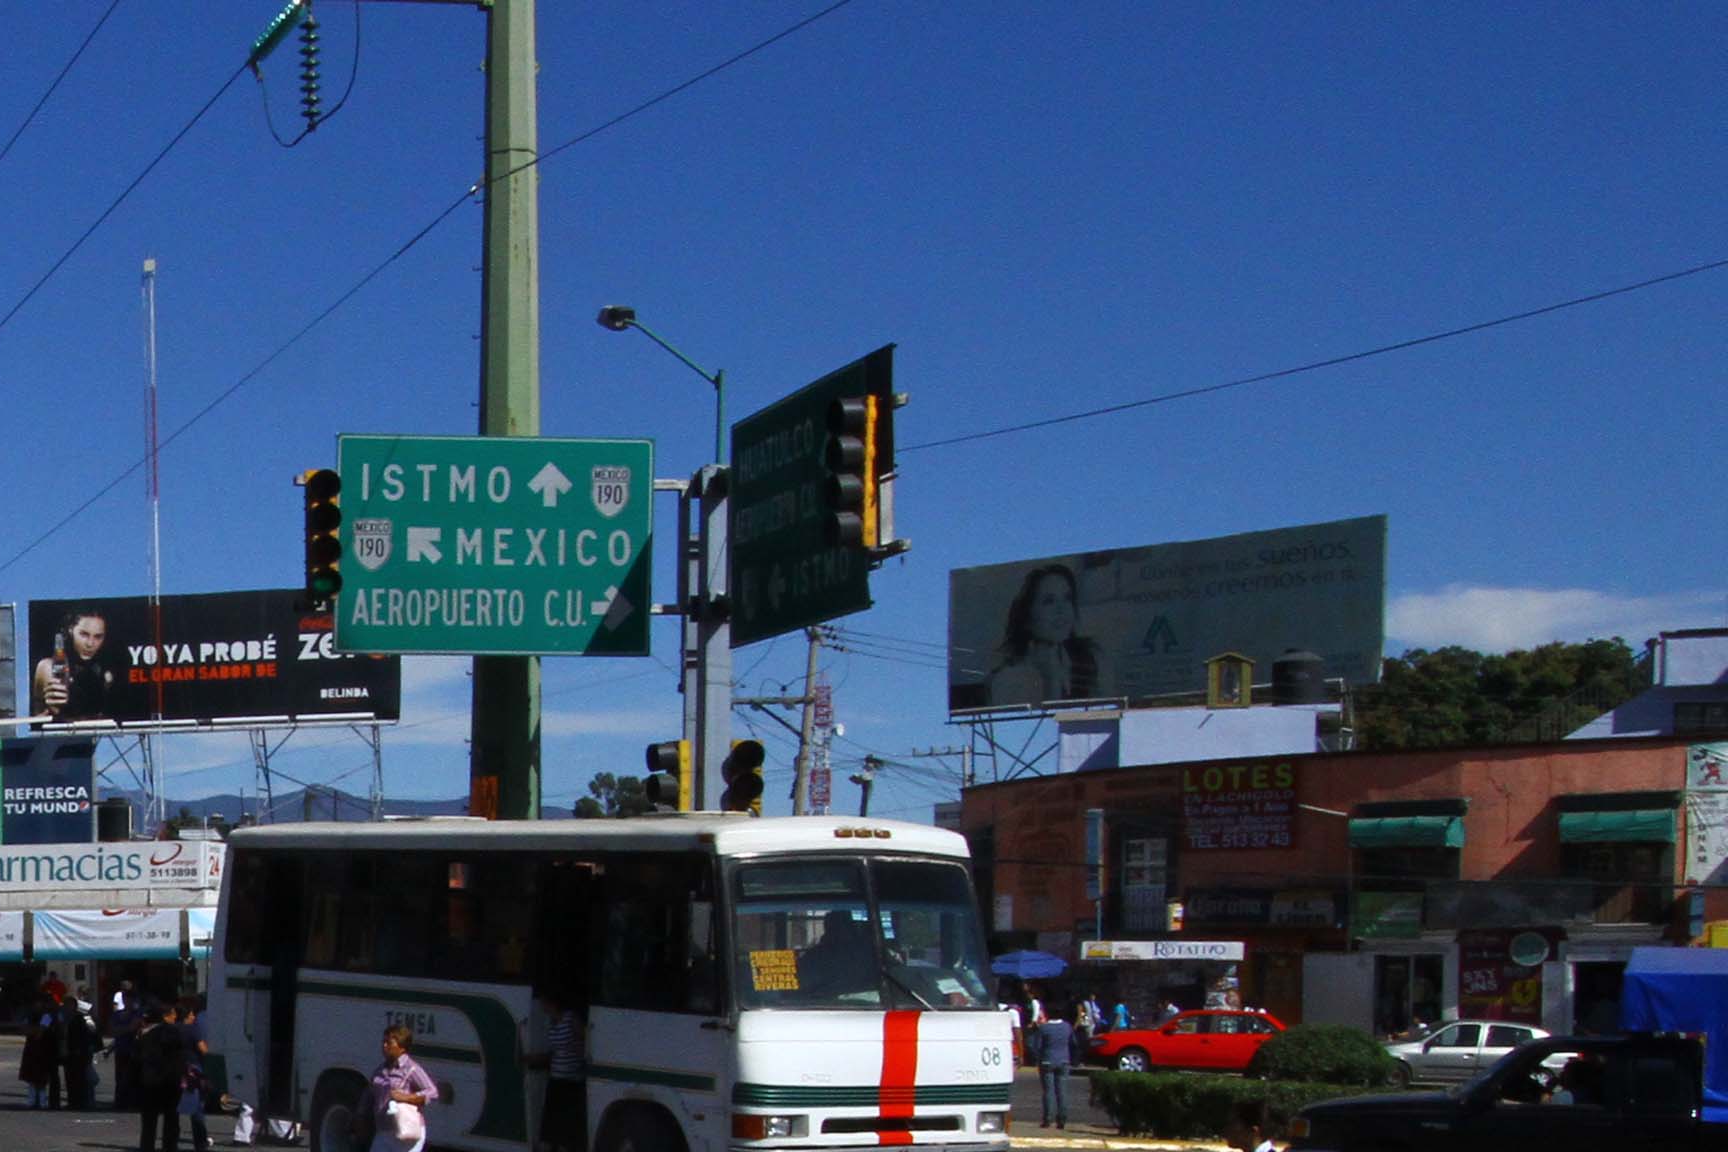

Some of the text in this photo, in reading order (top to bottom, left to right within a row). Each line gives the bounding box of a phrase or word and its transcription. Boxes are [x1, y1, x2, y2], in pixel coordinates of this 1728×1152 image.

[361, 463, 511, 502] ISTMO
[593, 469, 629, 481] MEXICO
[597, 484, 623, 505] 190
[355, 522, 390, 533] MEXICO
[359, 538, 384, 557] 190
[456, 528, 632, 566] MEXICO
[352, 588, 525, 627] AEROPUERTO
[544, 589, 587, 627] C.U.
[128, 633, 277, 665] YO YA PROBÉ
[128, 662, 277, 684] EL GRAN SABOR DE
[319, 687, 370, 699] BELINDA
[1184, 763, 1294, 792] LOTES
[4, 786, 88, 800] REFRESCA
[4, 801, 90, 814] TU MUNDO
[150, 867, 198, 878] 5113898
[209, 855, 220, 876] 24
[981, 1047, 1001, 1066] 08
